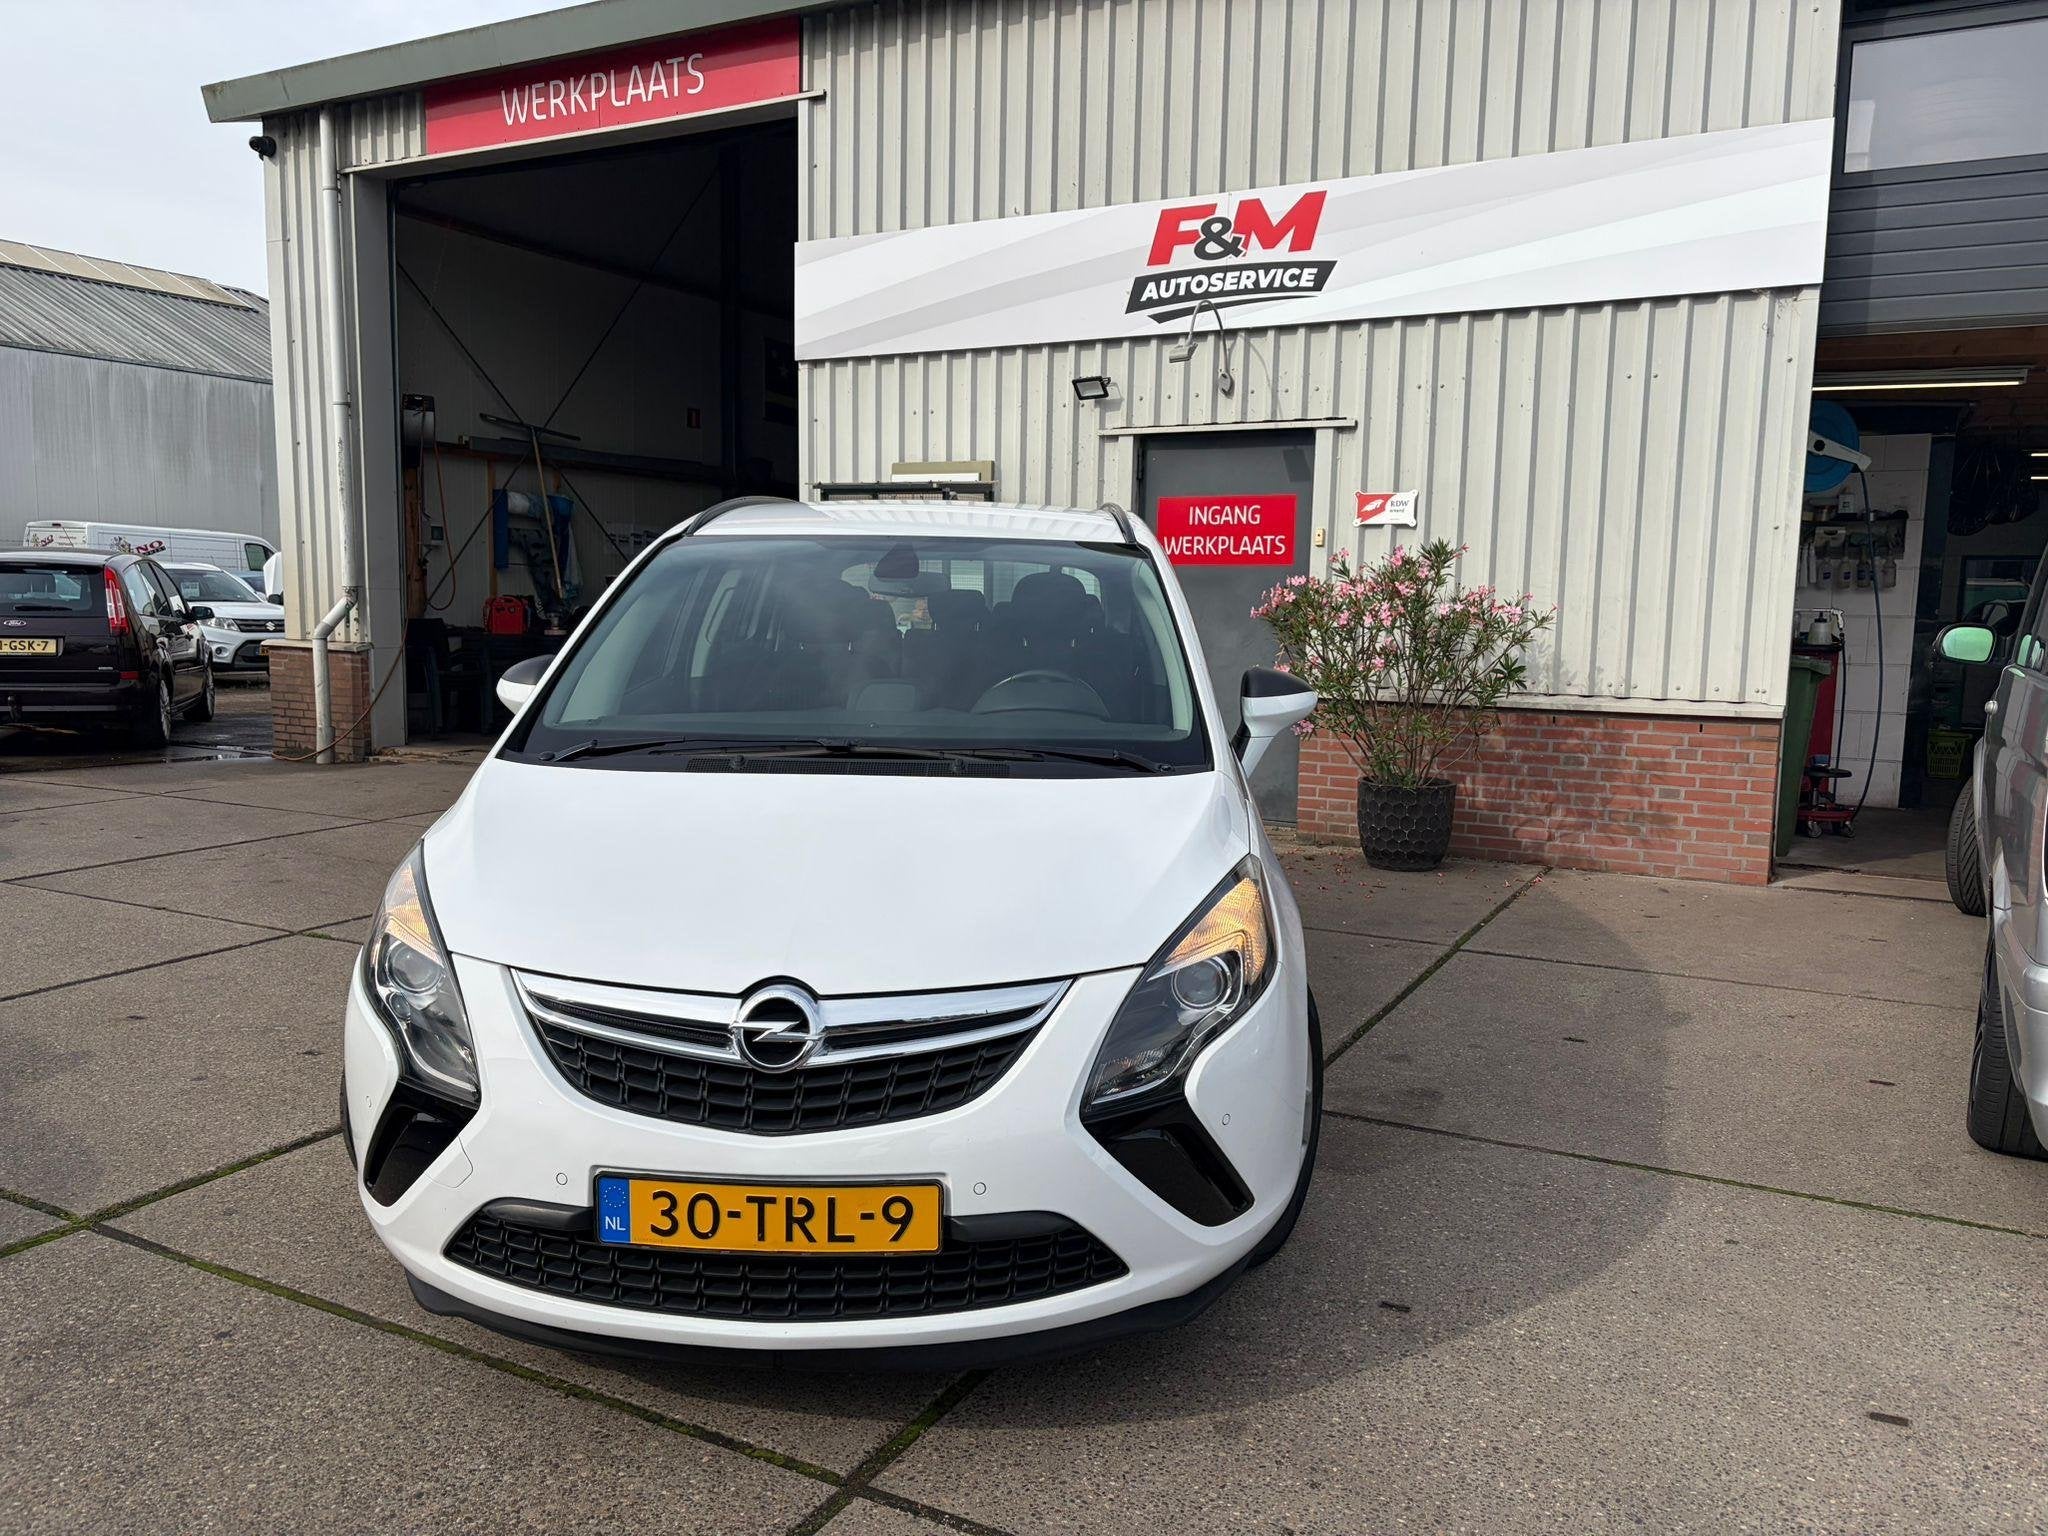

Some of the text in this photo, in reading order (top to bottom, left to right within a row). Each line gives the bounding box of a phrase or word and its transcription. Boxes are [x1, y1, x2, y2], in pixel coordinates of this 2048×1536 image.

[501, 53, 706, 126] WERKPLAATS
[1147, 190, 1327, 266] F&M
[1140, 267, 1318, 302] AUTOSERVICE
[1188, 505, 1261, 526] INGANG
[1163, 534, 1287, 556] WERKPLAATS
[605, 1216, 626, 1231] NL
[650, 1190, 914, 1243] 30-TRL-9
